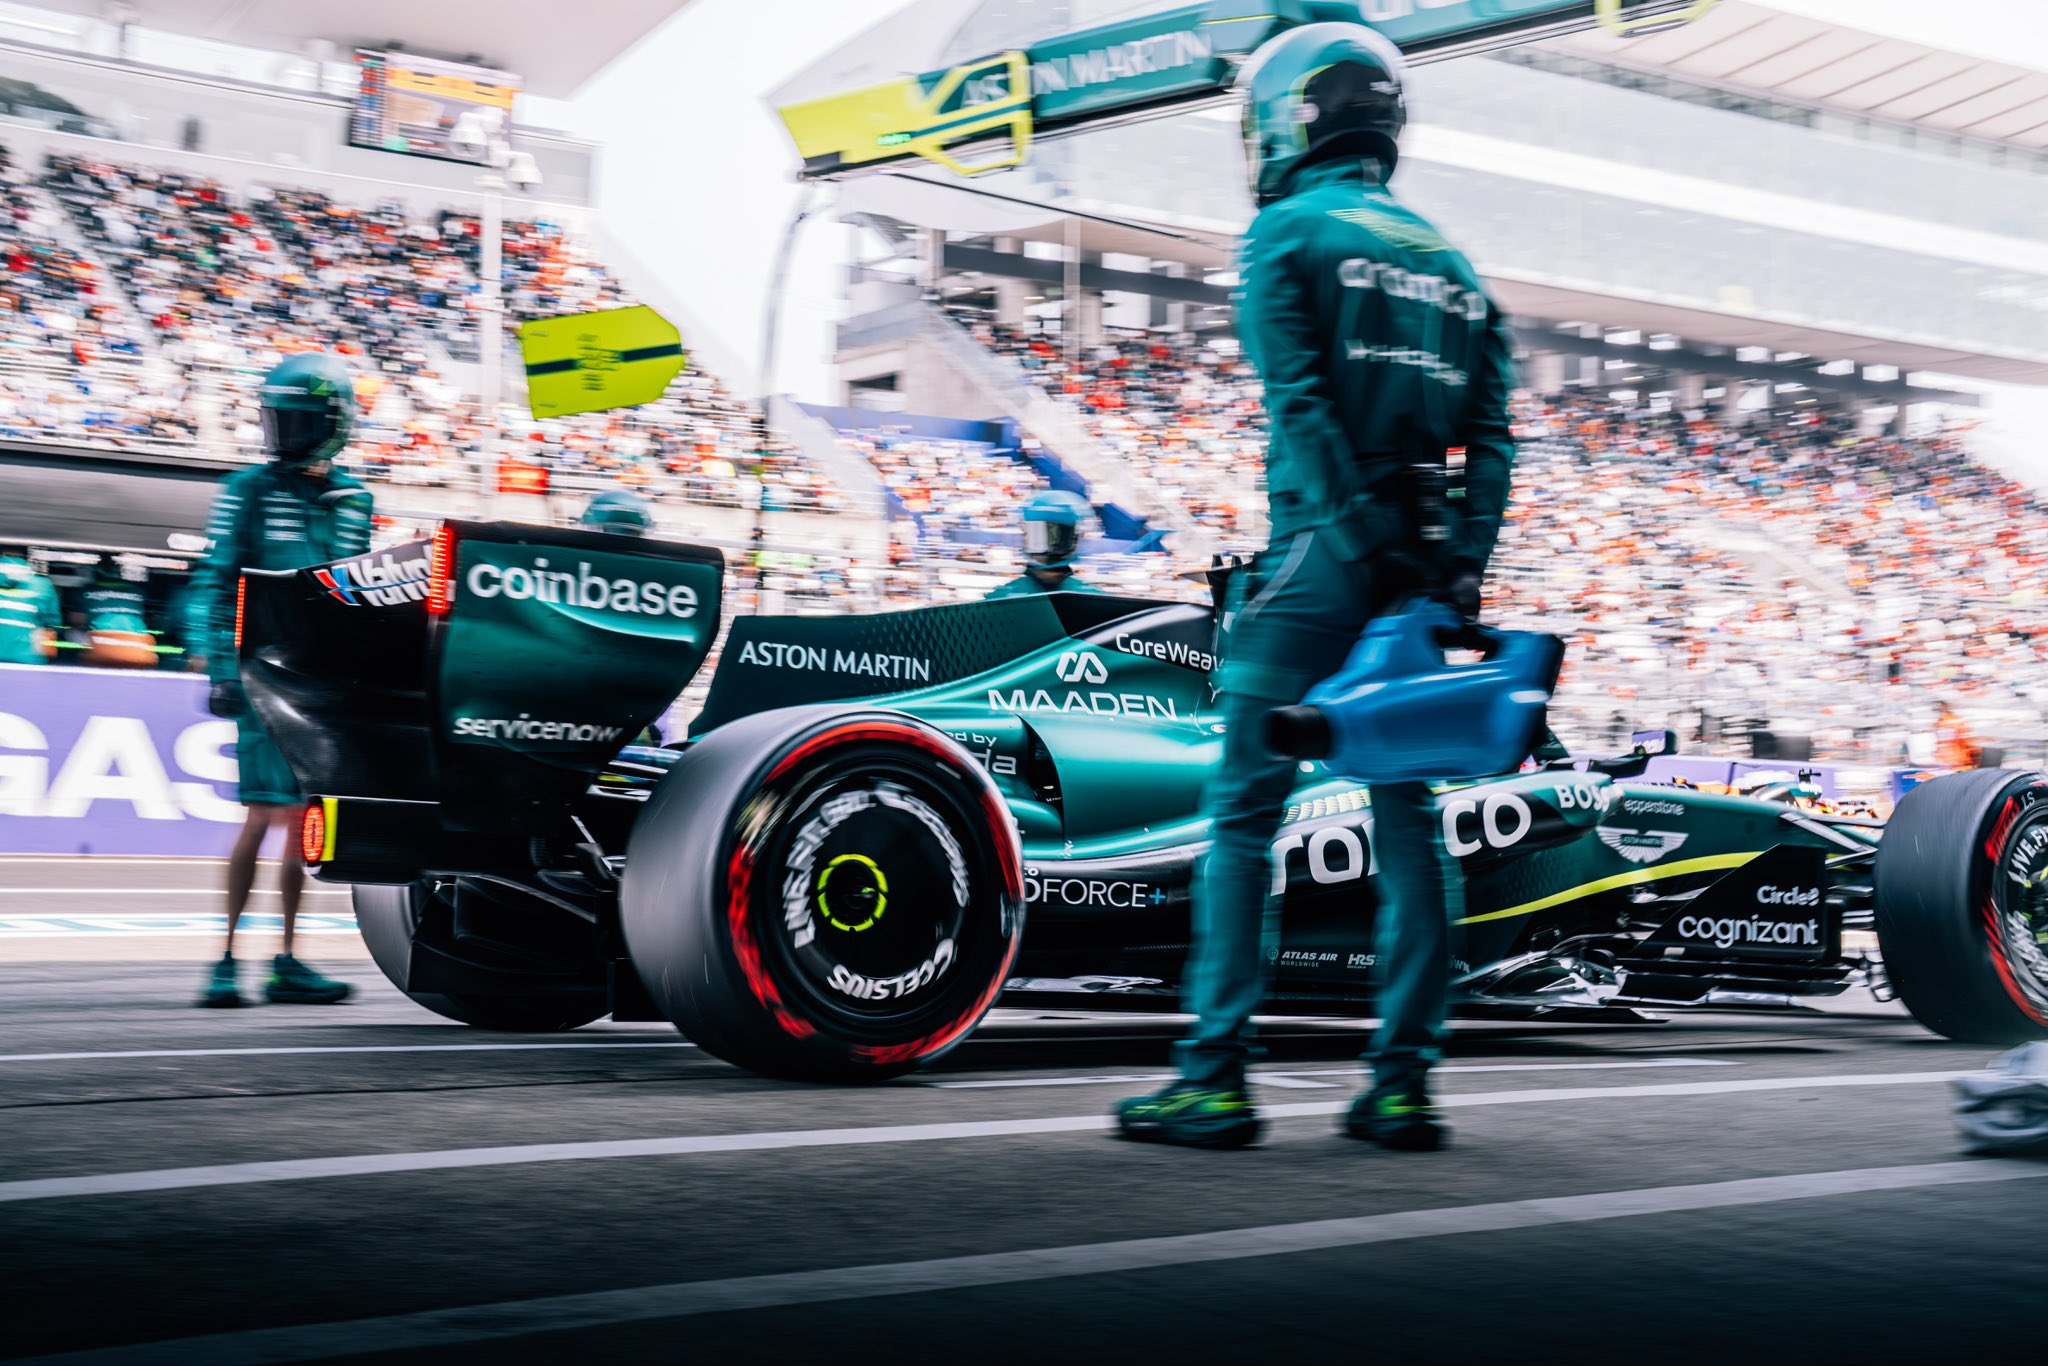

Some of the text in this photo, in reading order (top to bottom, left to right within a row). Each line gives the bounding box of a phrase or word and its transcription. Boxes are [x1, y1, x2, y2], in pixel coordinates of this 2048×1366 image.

[466, 558, 698, 618] coinbase
[738, 640, 930, 682] ASTON MARTIN
[1116, 633, 1225, 672] CoreWeav
[988, 689, 1177, 721] MAADEN
[453, 713, 624, 742] servicenow
[972, 732, 997, 747] by
[1678, 914, 1819, 949] cognizant
[1280, 960, 1319, 968] WORLDWIDE
[1281, 951, 1338, 961] ATLAS AIR
